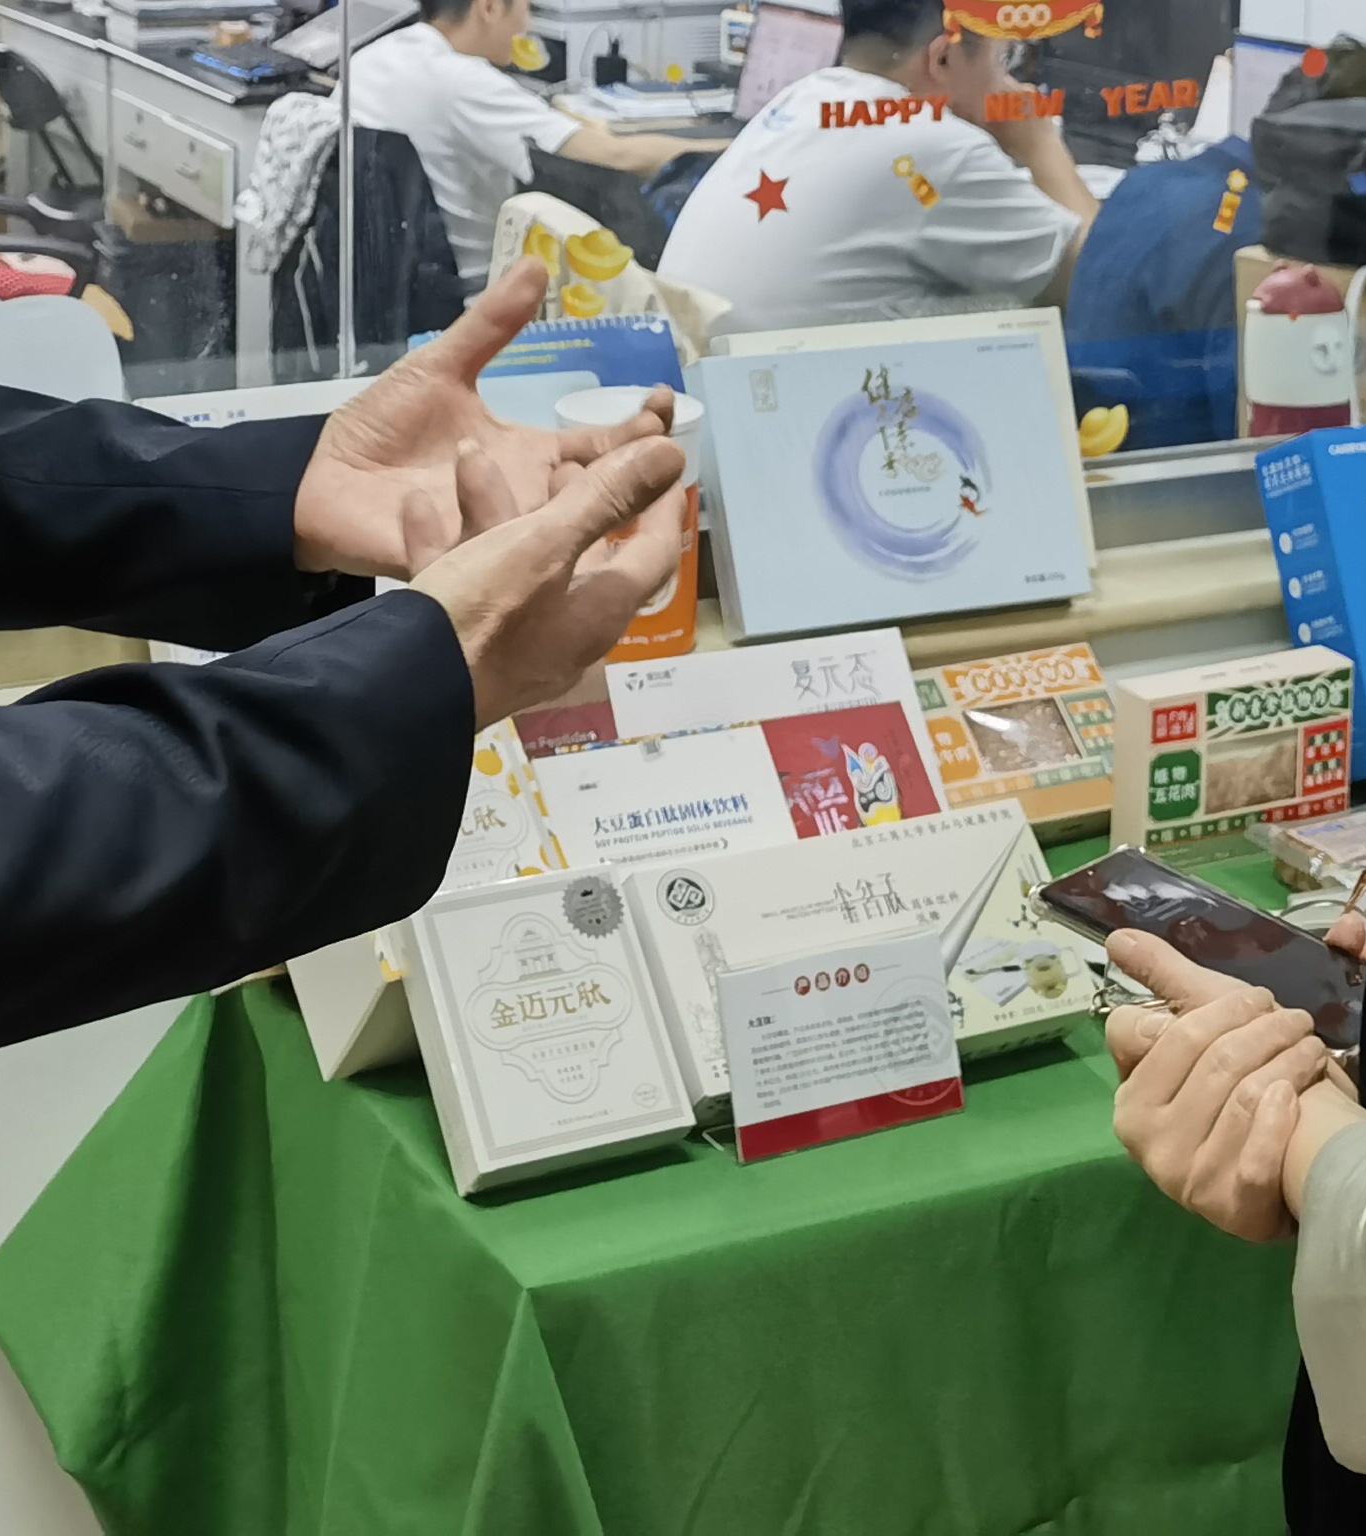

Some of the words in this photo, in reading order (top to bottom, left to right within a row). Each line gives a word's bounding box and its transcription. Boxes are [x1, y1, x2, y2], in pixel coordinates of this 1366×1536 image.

[819, 93, 950, 130] HAPPY
[984, 88, 1066, 123] NEW
[1100, 78, 1199, 119] YEAR
[489, 978, 612, 1030] 金迈元肽
